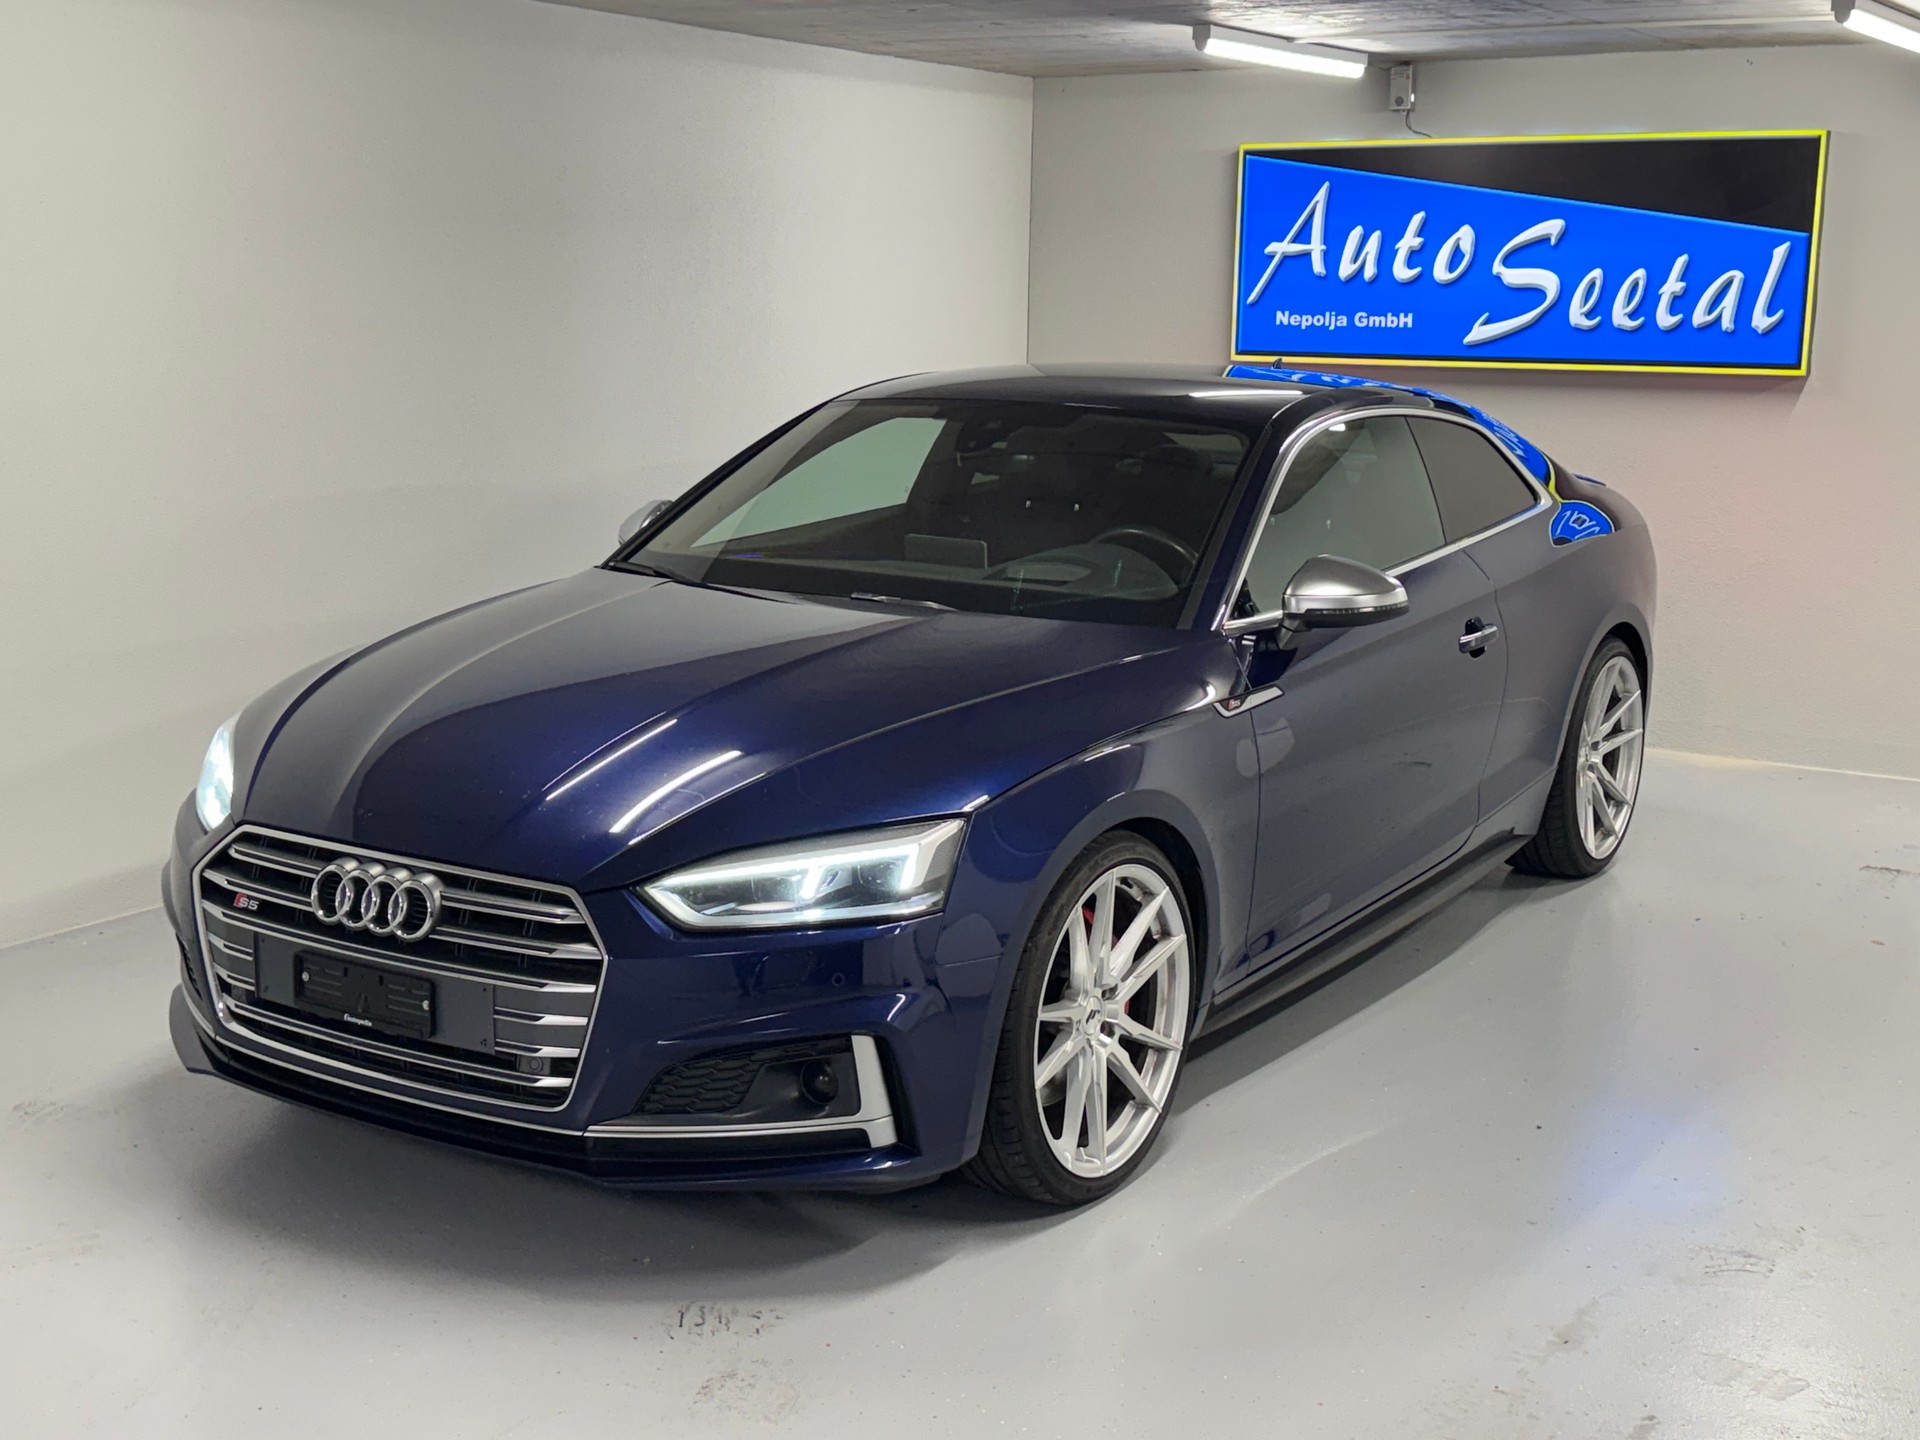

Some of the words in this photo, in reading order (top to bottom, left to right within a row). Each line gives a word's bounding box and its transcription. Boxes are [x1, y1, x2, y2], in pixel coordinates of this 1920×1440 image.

[1247, 181, 1476, 304] Auto
[1462, 218, 1791, 346] Seetal
[1275, 310, 1348, 330] Nepolja
[1354, 311, 1413, 328] GmbH
[238, 896, 260, 911] S5
